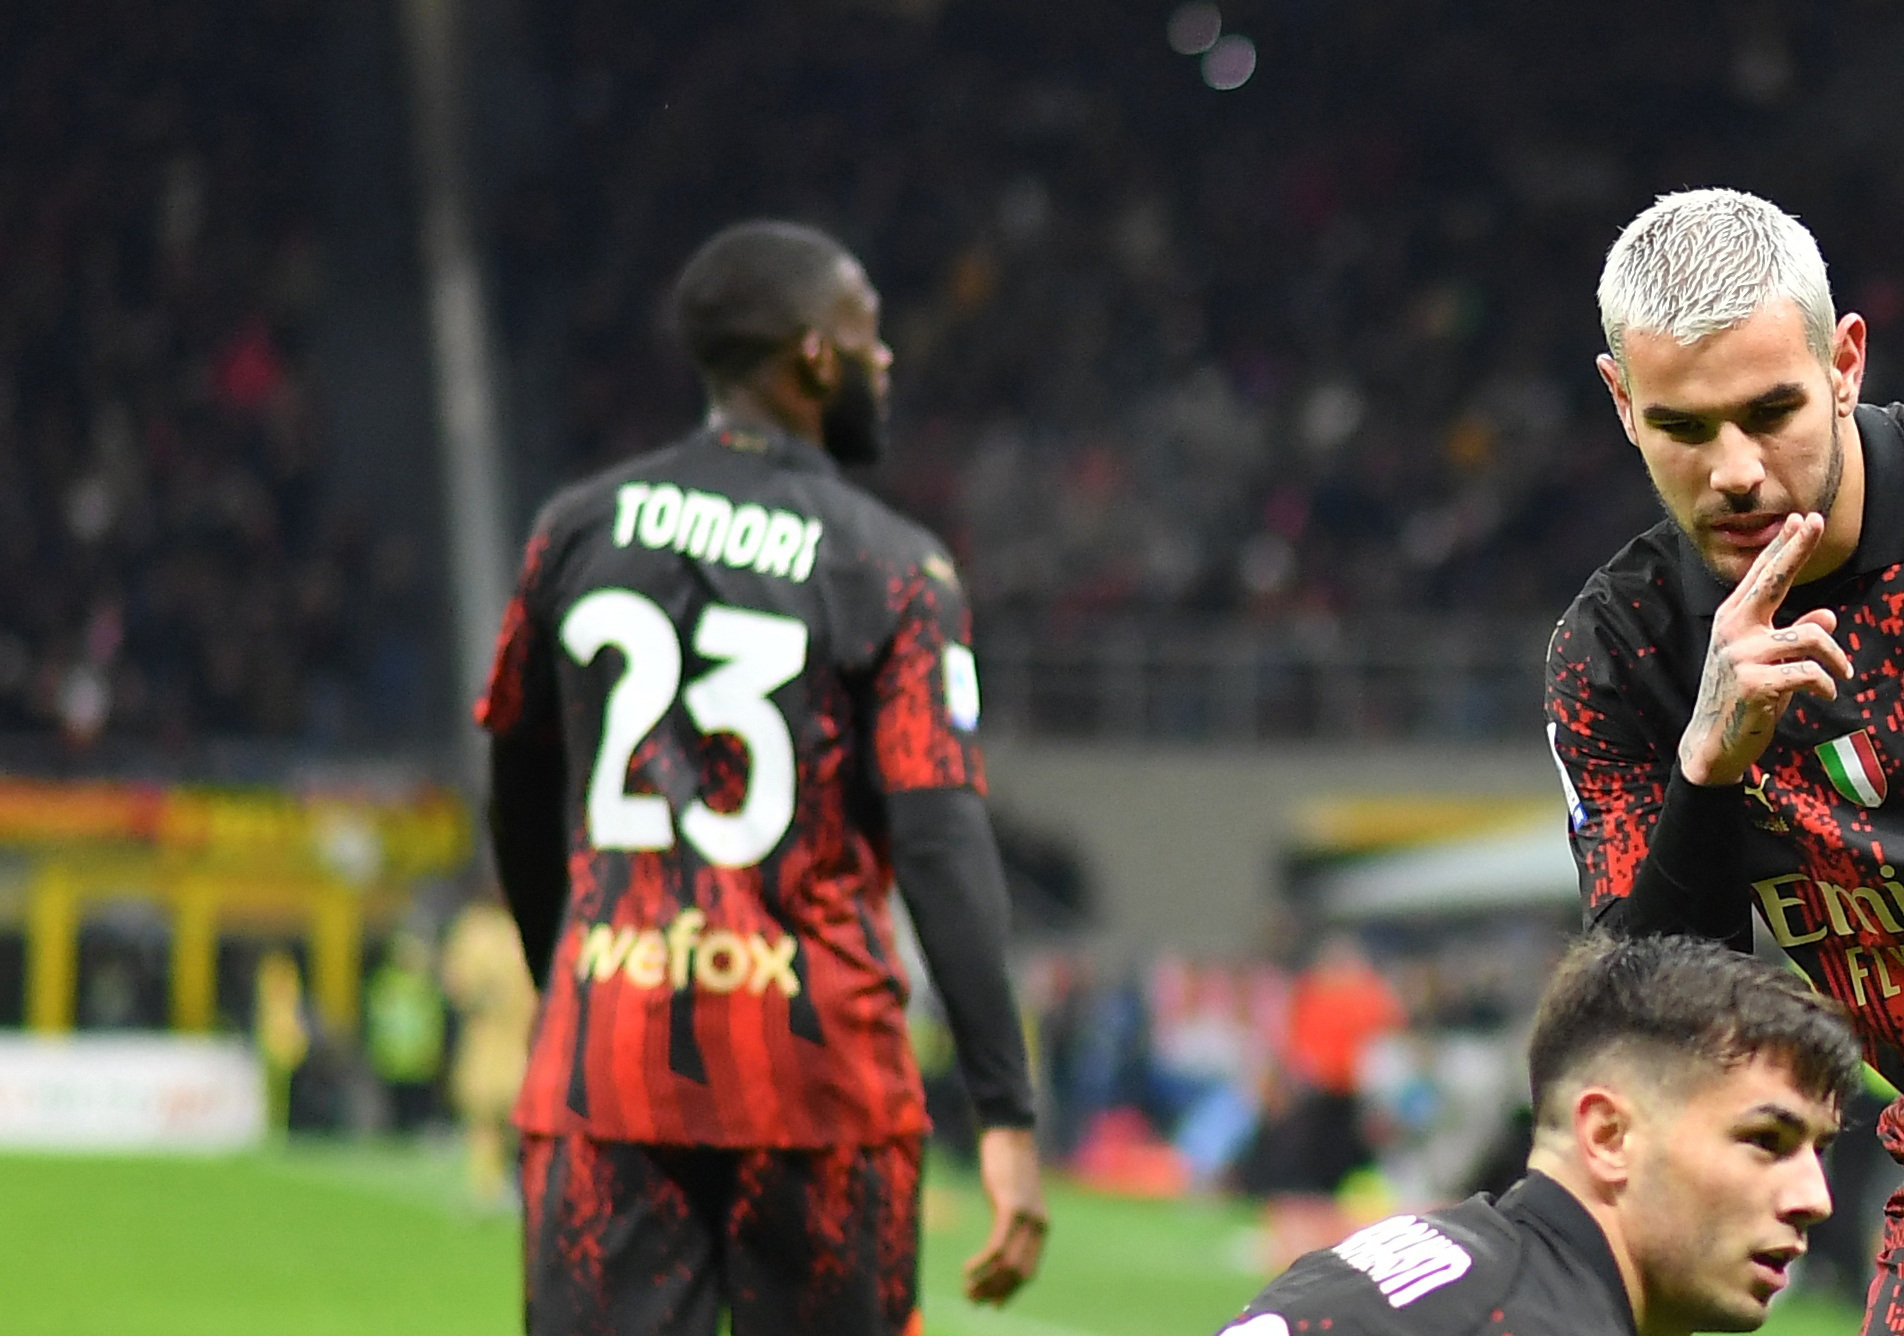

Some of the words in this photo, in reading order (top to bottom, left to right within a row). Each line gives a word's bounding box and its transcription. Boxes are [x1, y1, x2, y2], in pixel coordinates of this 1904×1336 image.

[612, 481, 823, 583] TOMORI
[559, 587, 809, 870] 23
[577, 907, 800, 996] wefox
